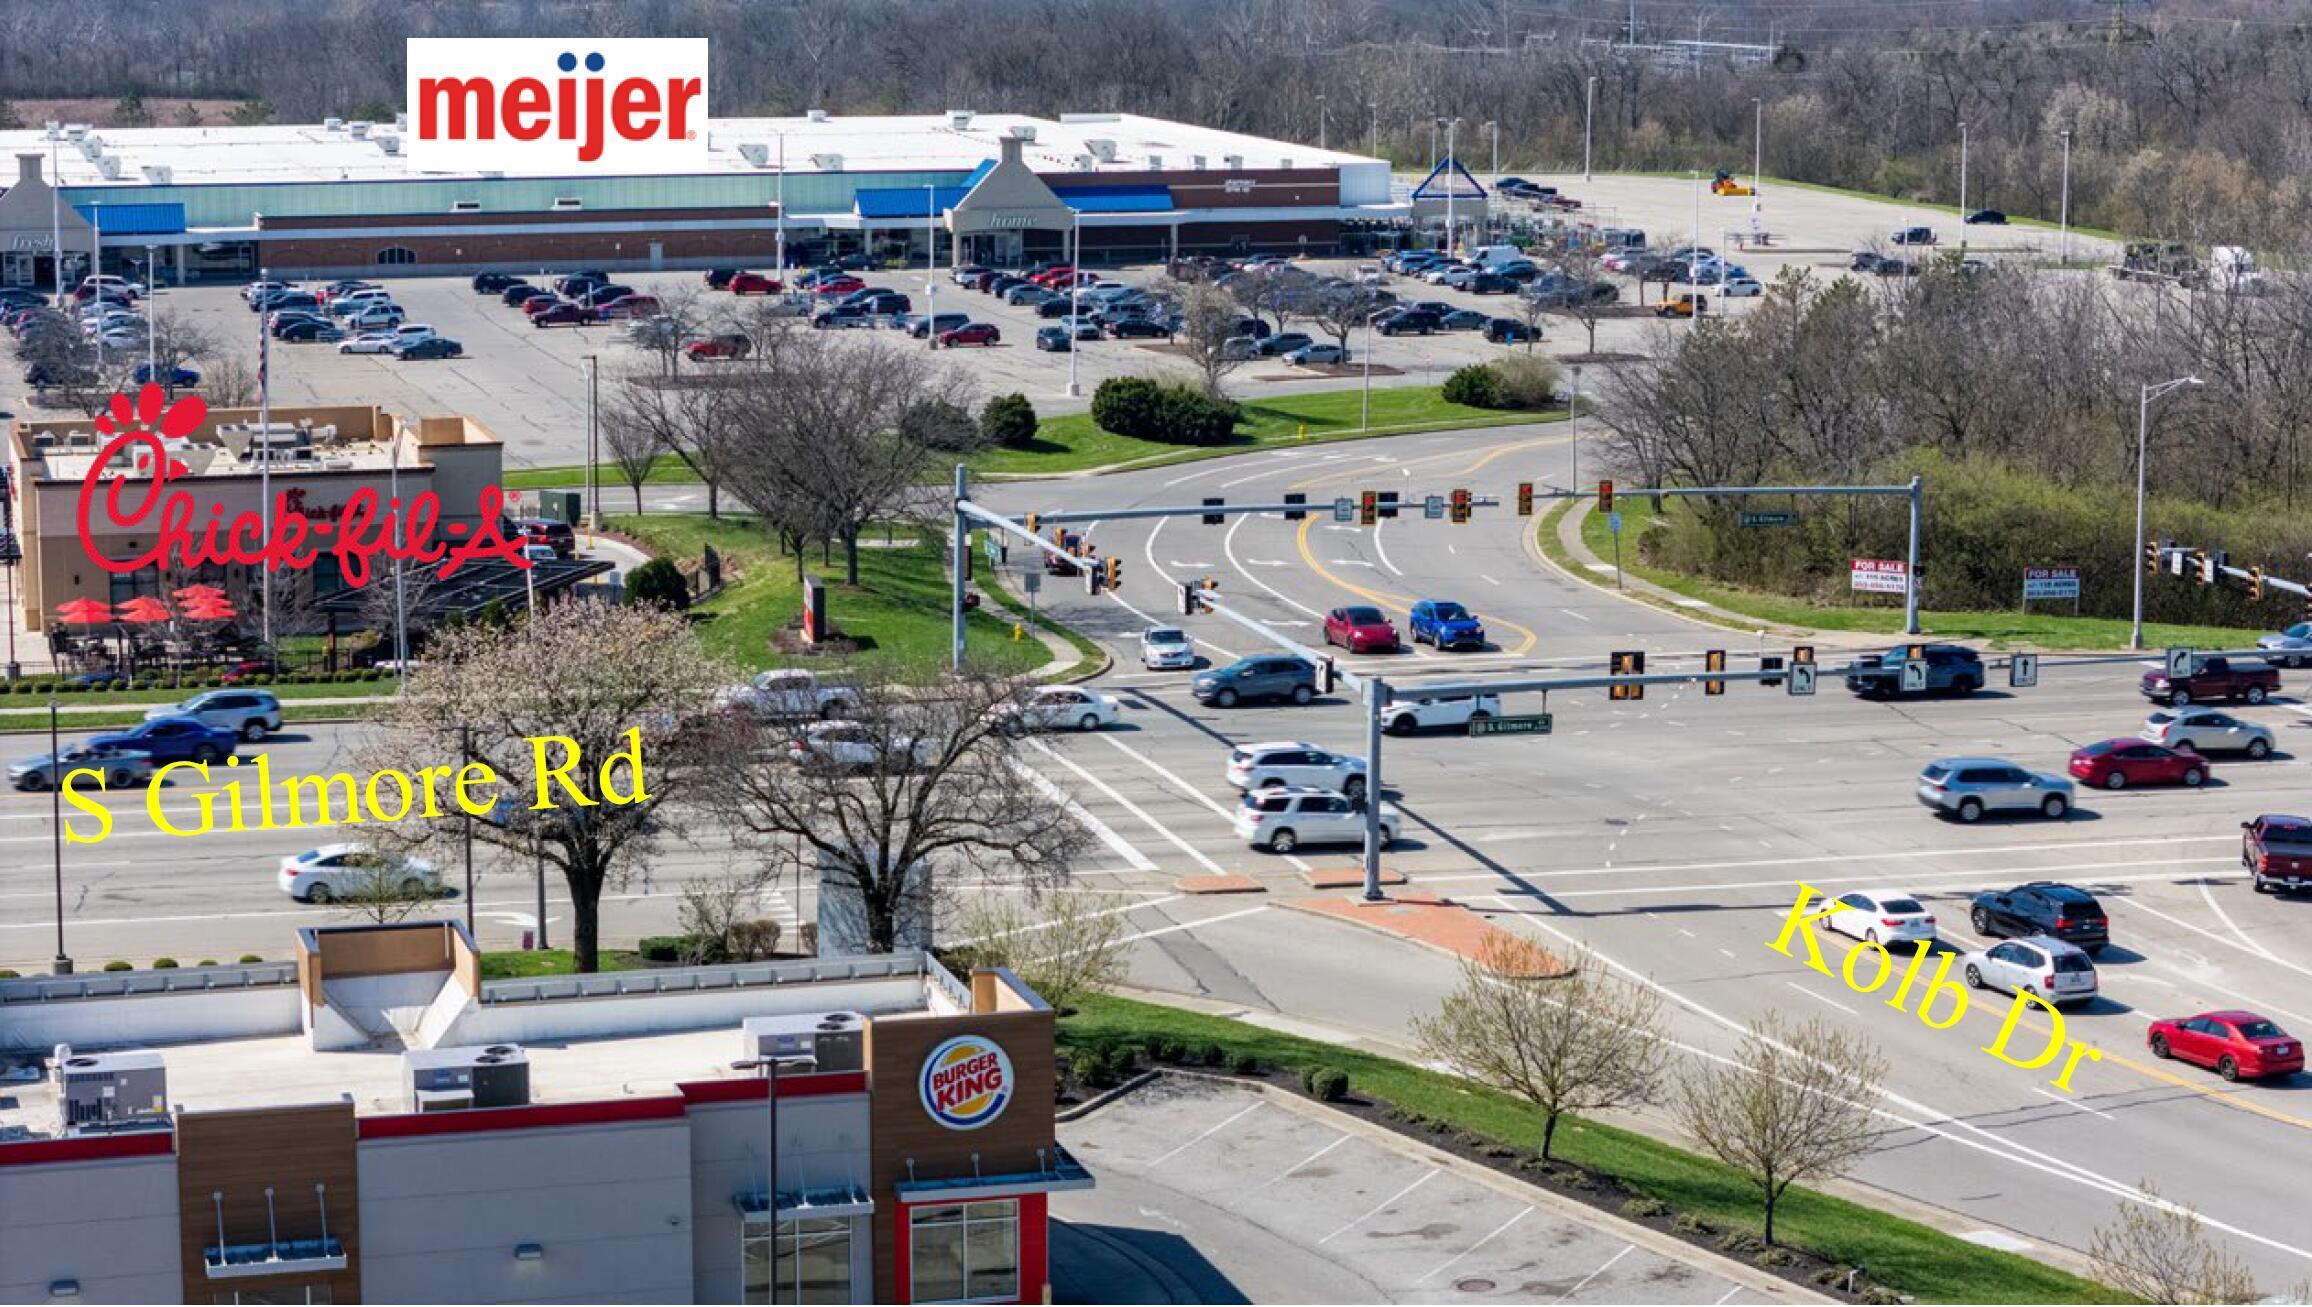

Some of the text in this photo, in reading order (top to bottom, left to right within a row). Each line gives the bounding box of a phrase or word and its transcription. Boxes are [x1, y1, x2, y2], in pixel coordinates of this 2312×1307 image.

[989, 212, 1038, 228] home
[1855, 559, 1904, 573] FOR SALE
[2029, 568, 2076, 578] FOR SALE
[933, 1052, 998, 1090] BURGER
[936, 1067, 1003, 1112] KING
